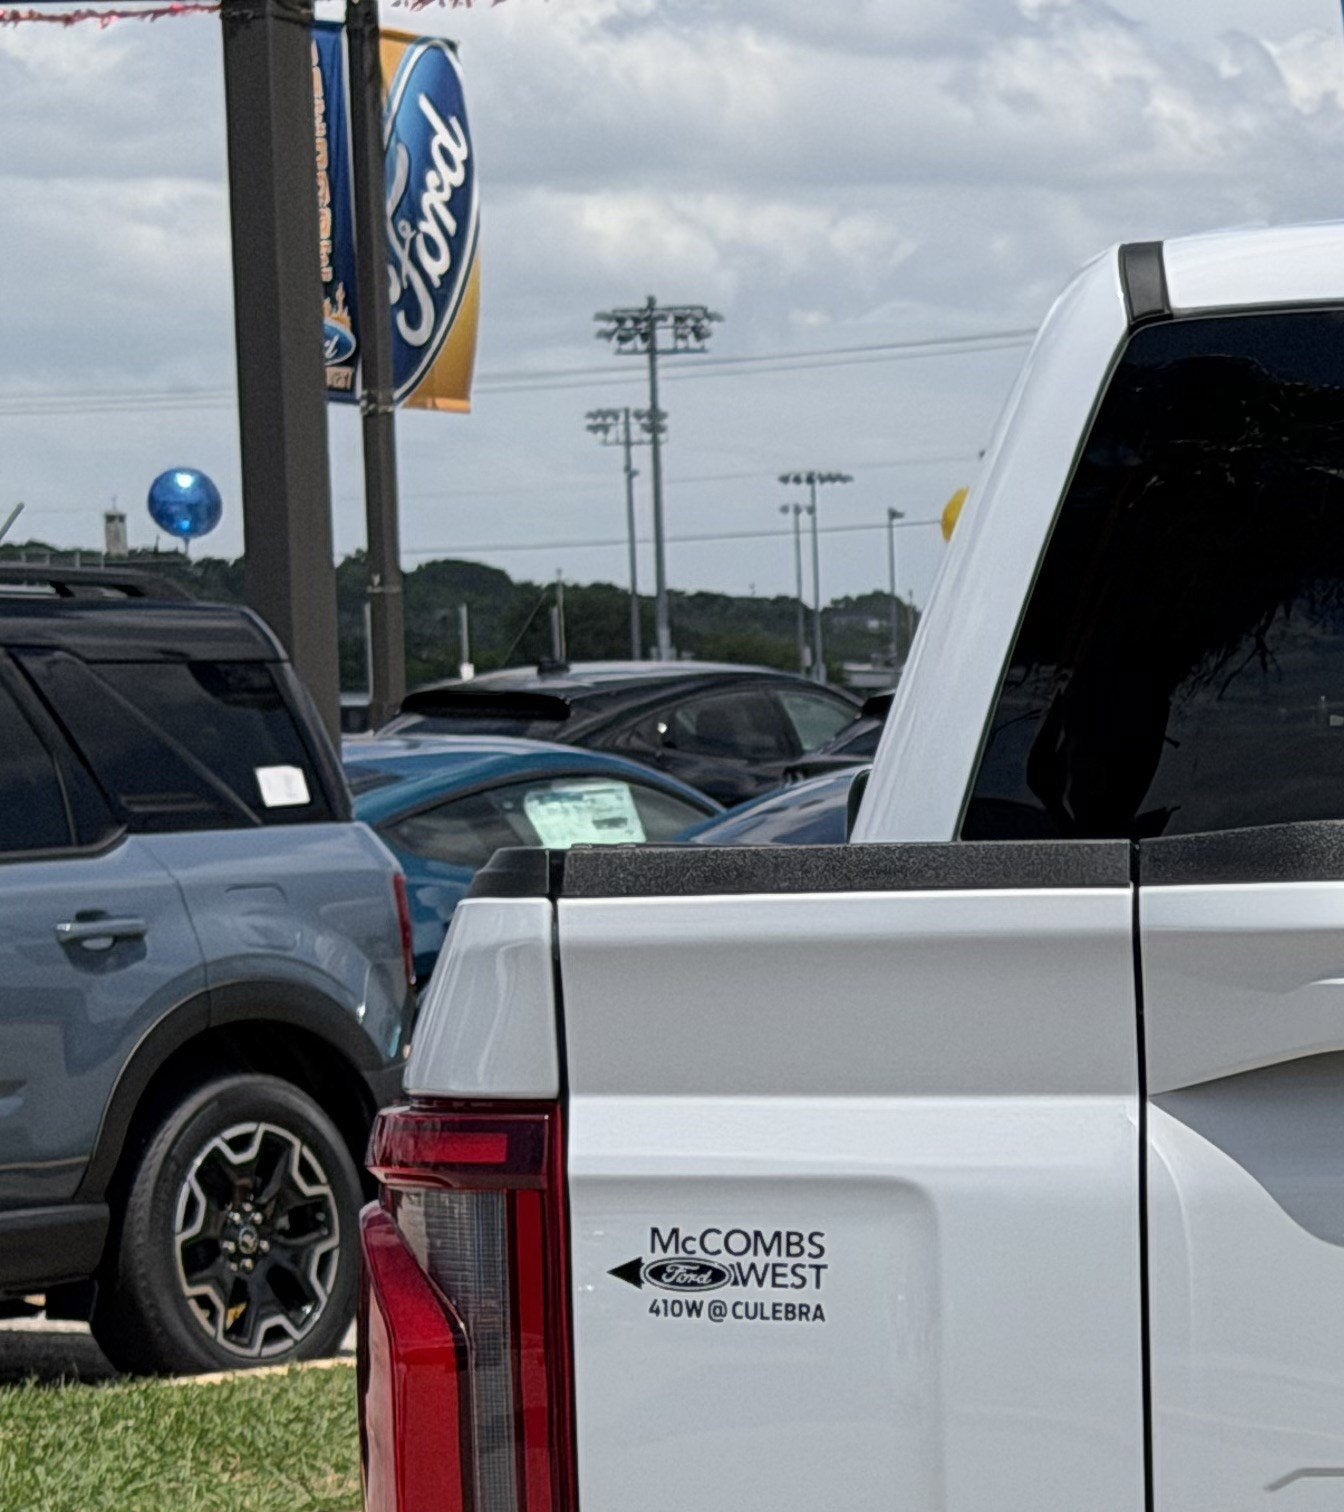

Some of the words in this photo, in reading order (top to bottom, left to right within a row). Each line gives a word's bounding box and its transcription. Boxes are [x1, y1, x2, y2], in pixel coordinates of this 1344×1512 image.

[650, 1227, 826, 1259] McCOMBS
[661, 1263, 714, 1285] Ford
[734, 1261, 828, 1289] WEST
[731, 1301, 826, 1322] CULEBRA
